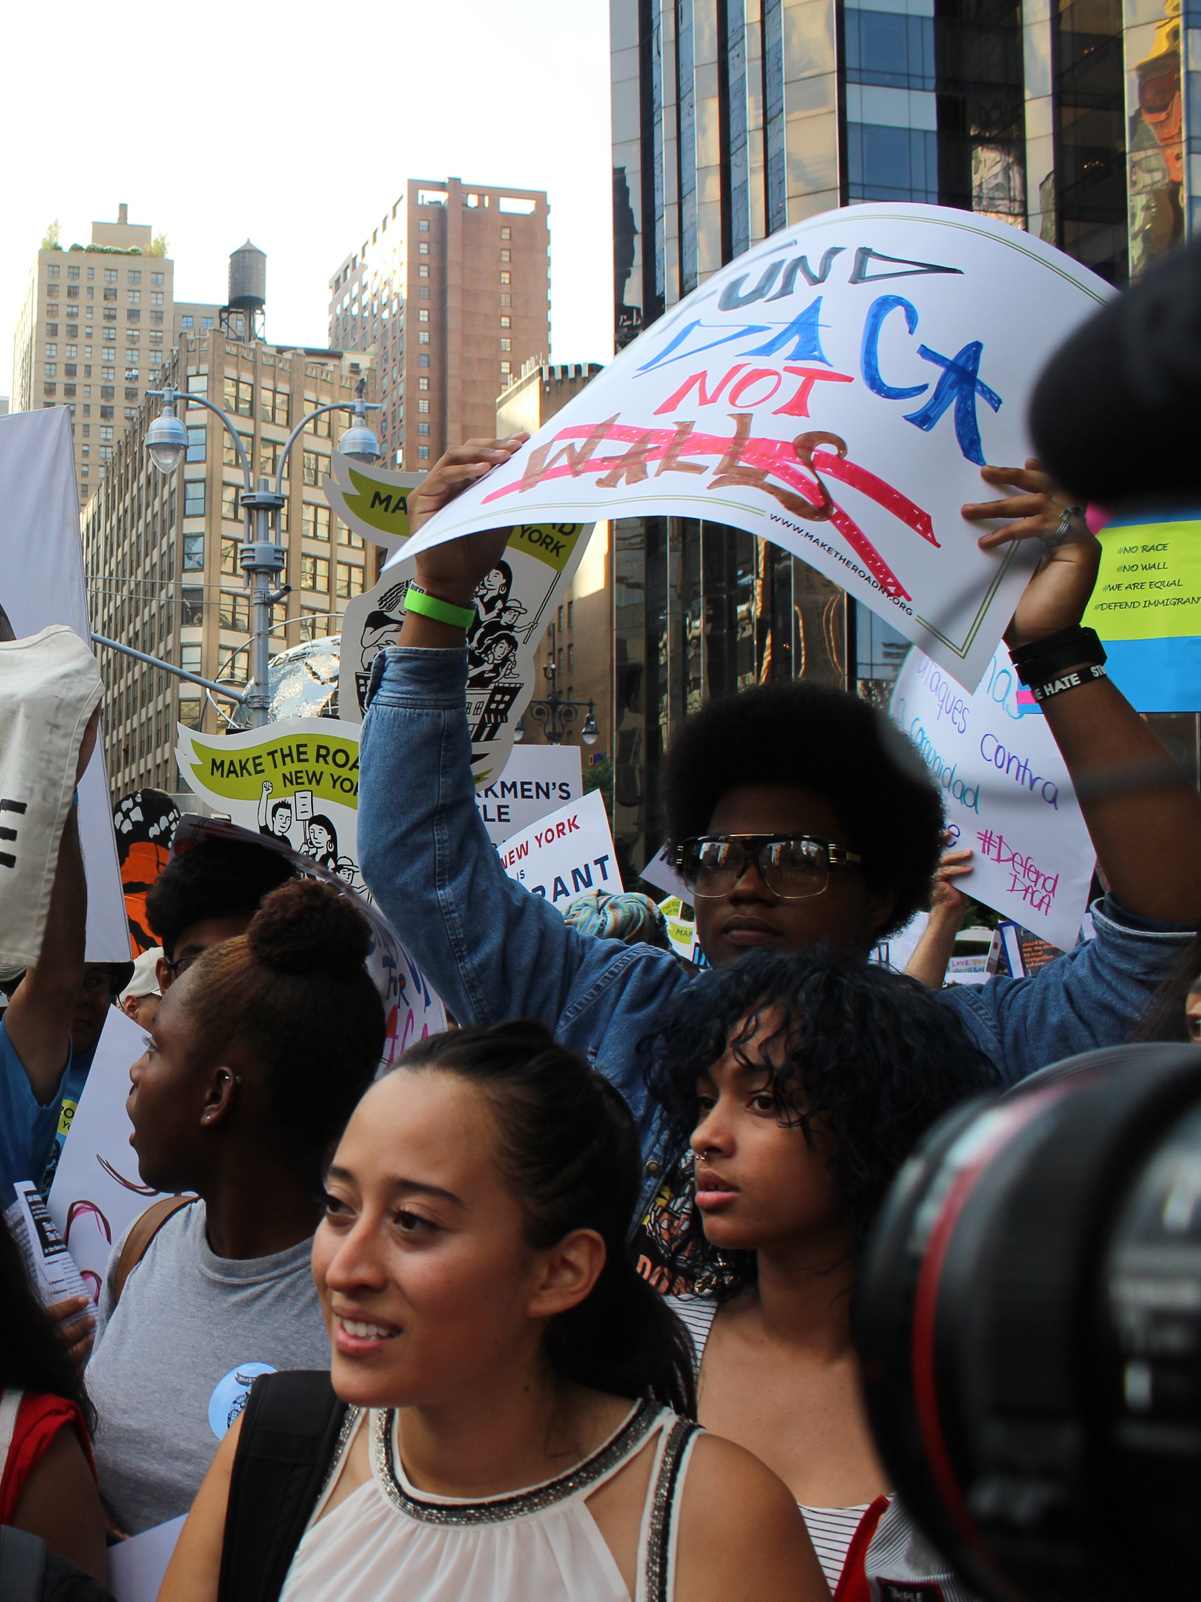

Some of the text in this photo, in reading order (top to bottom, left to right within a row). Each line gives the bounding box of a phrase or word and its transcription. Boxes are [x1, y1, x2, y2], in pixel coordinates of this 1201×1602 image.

[633, 294, 1003, 467] DACA
[653, 362, 854, 418] NOT
[519, 413, 849, 522] WALLS
[518, 525, 568, 558] YORK
[1141, 543, 1169, 553] RACE
[1141, 562, 1168, 571] WALL
[1125, 581, 1146, 591] ARE
[1149, 579, 1183, 590] EQUAL
[1043, 673, 1082, 696] HATE
[210, 746, 265, 779] MAKE
[267, 743, 309, 770] THE
[282, 769, 323, 789] NEW
[475, 780, 571, 801] KMEN'S
[500, 814, 581, 870] NEW YORK
[516, 869, 526, 881] IS
